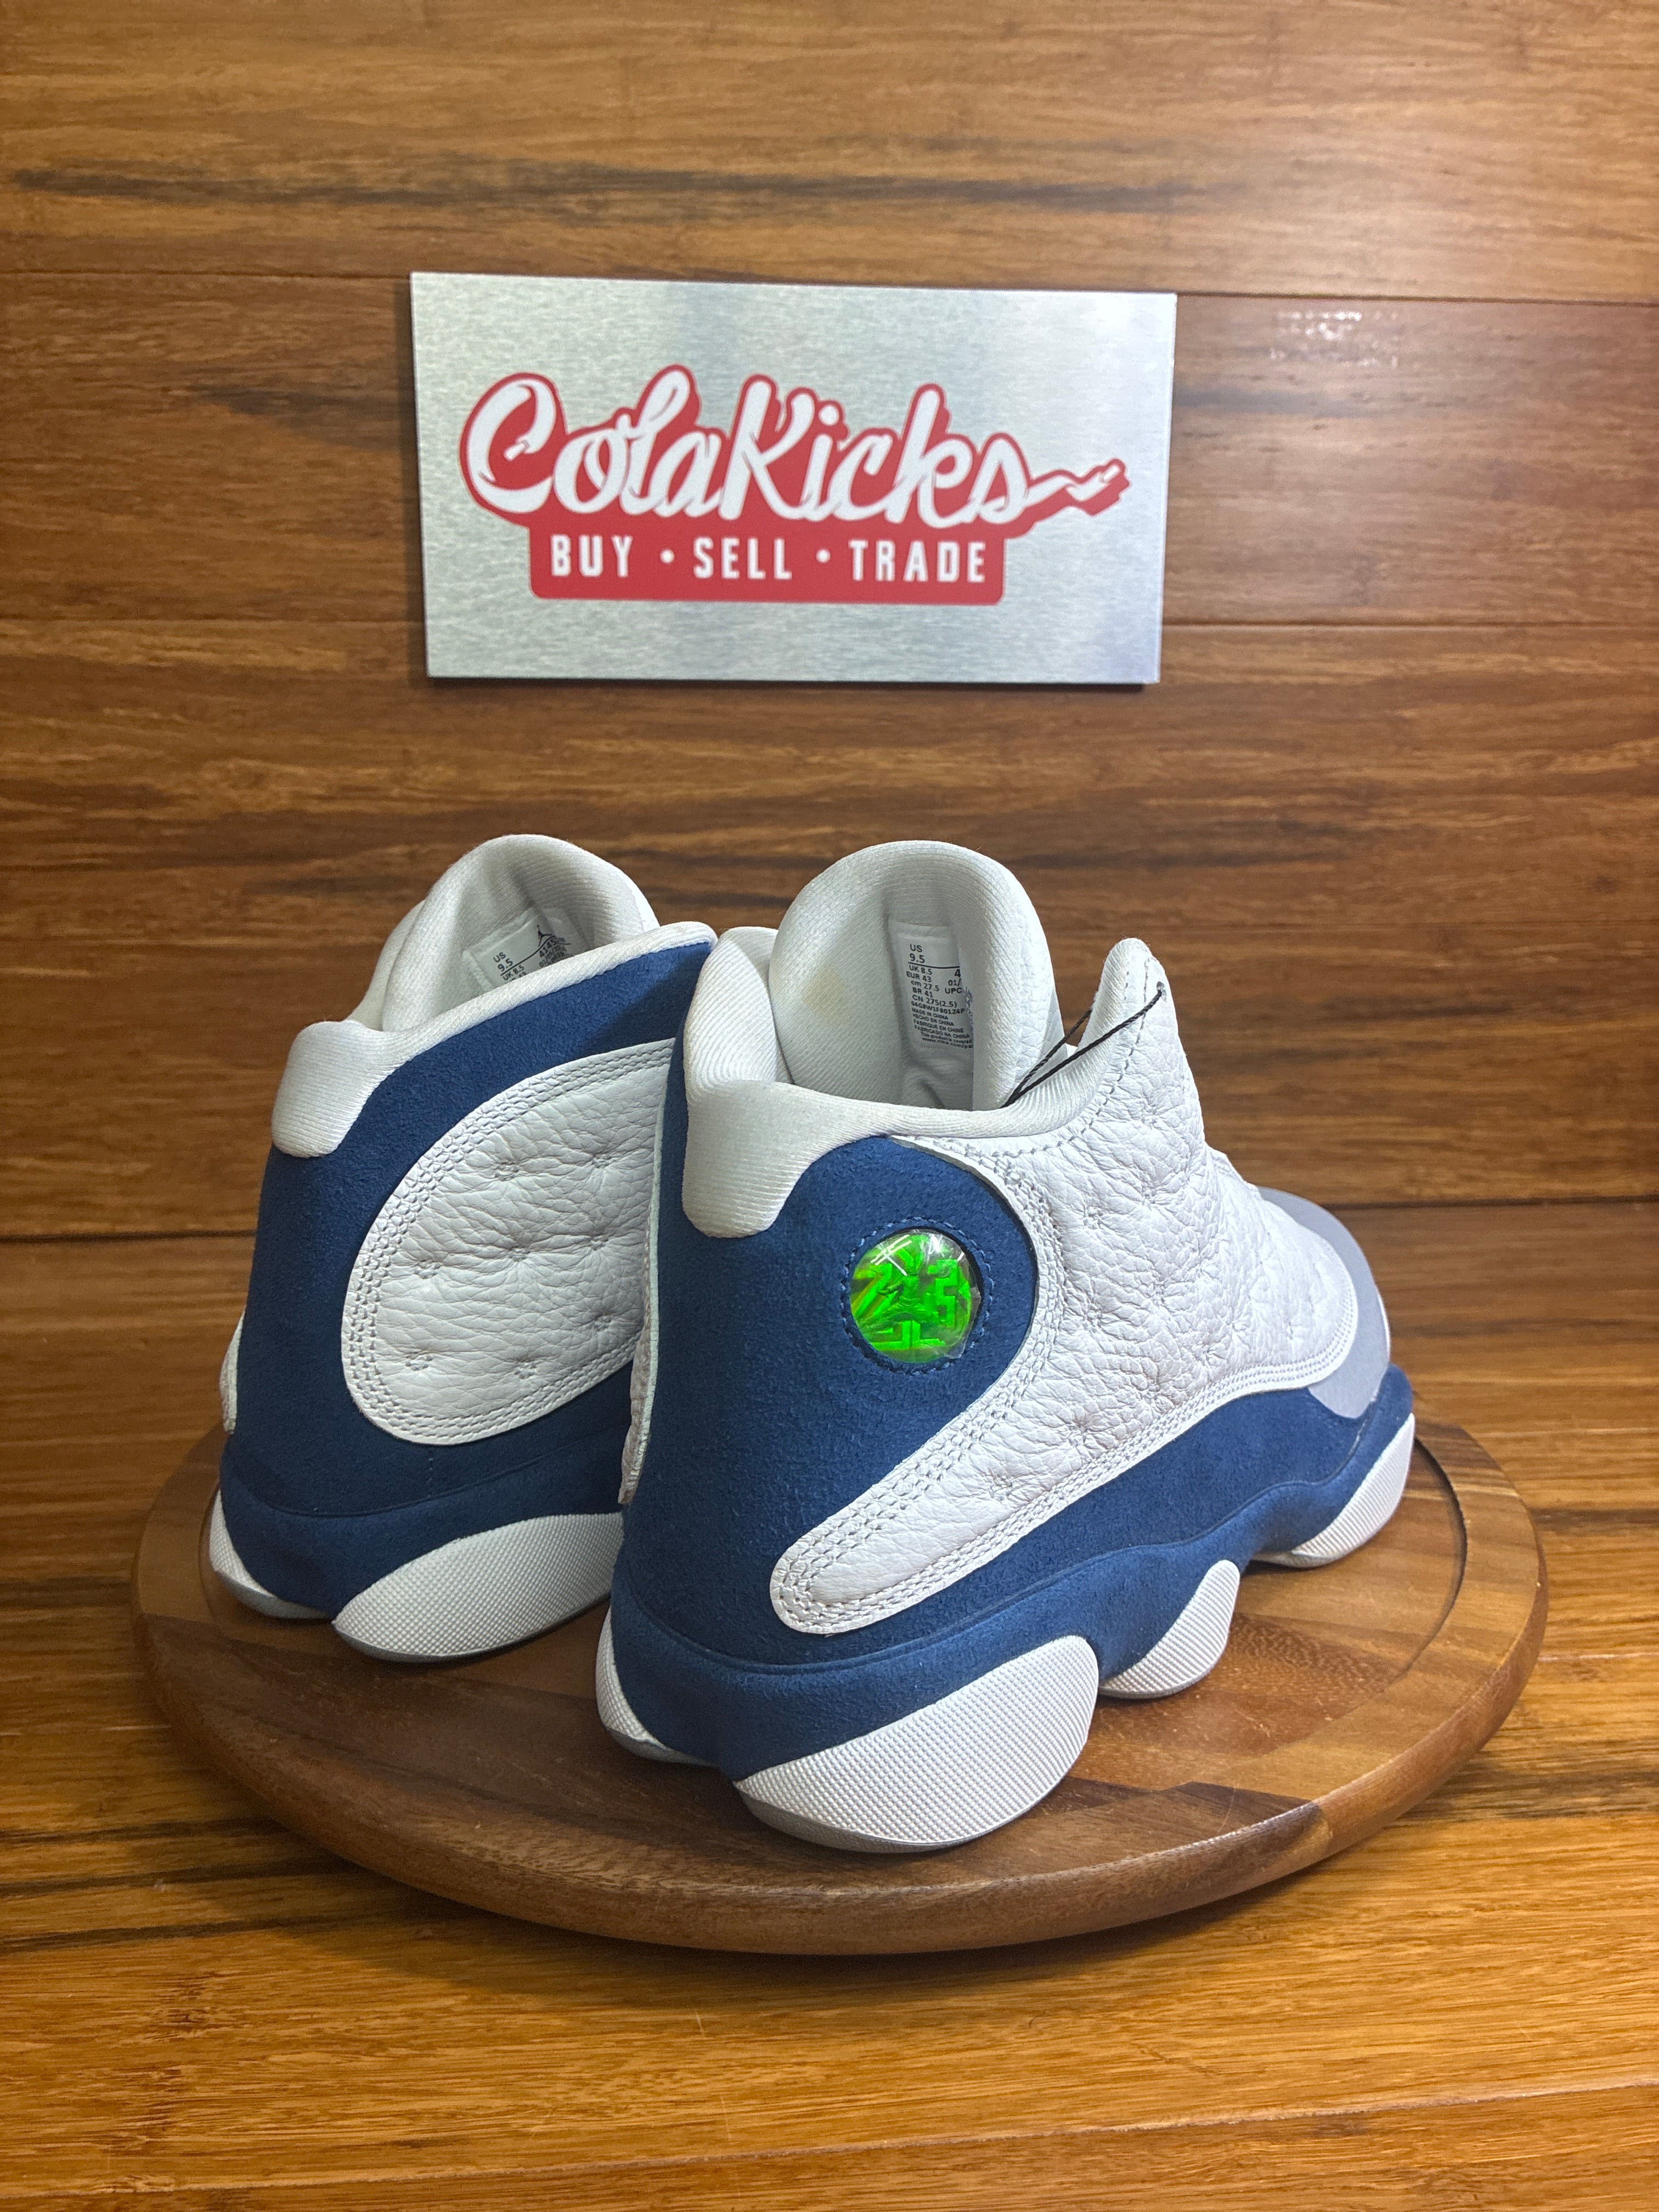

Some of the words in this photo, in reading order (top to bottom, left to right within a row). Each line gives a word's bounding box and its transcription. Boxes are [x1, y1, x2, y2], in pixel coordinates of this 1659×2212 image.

[464, 366, 1124, 525] ColaKicks
[550, 534, 633, 579] BUY
[692, 537, 794, 581] SELL
[850, 540, 987, 584] TRADE
[910, 944, 923, 952] US
[493, 952, 506, 963] US
[909, 953, 925, 963] 9.5
[498, 958, 513, 972] 9.5
[502, 970, 514, 980] UK
[513, 964, 524, 975] 8.5
[906, 971, 920, 980] EUR
[923, 983, 940, 992] 27.5
[912, 994, 923, 1002] CN
[926, 997, 957, 1008] 275(2.5)
[911, 1007, 925, 1015] MADE
